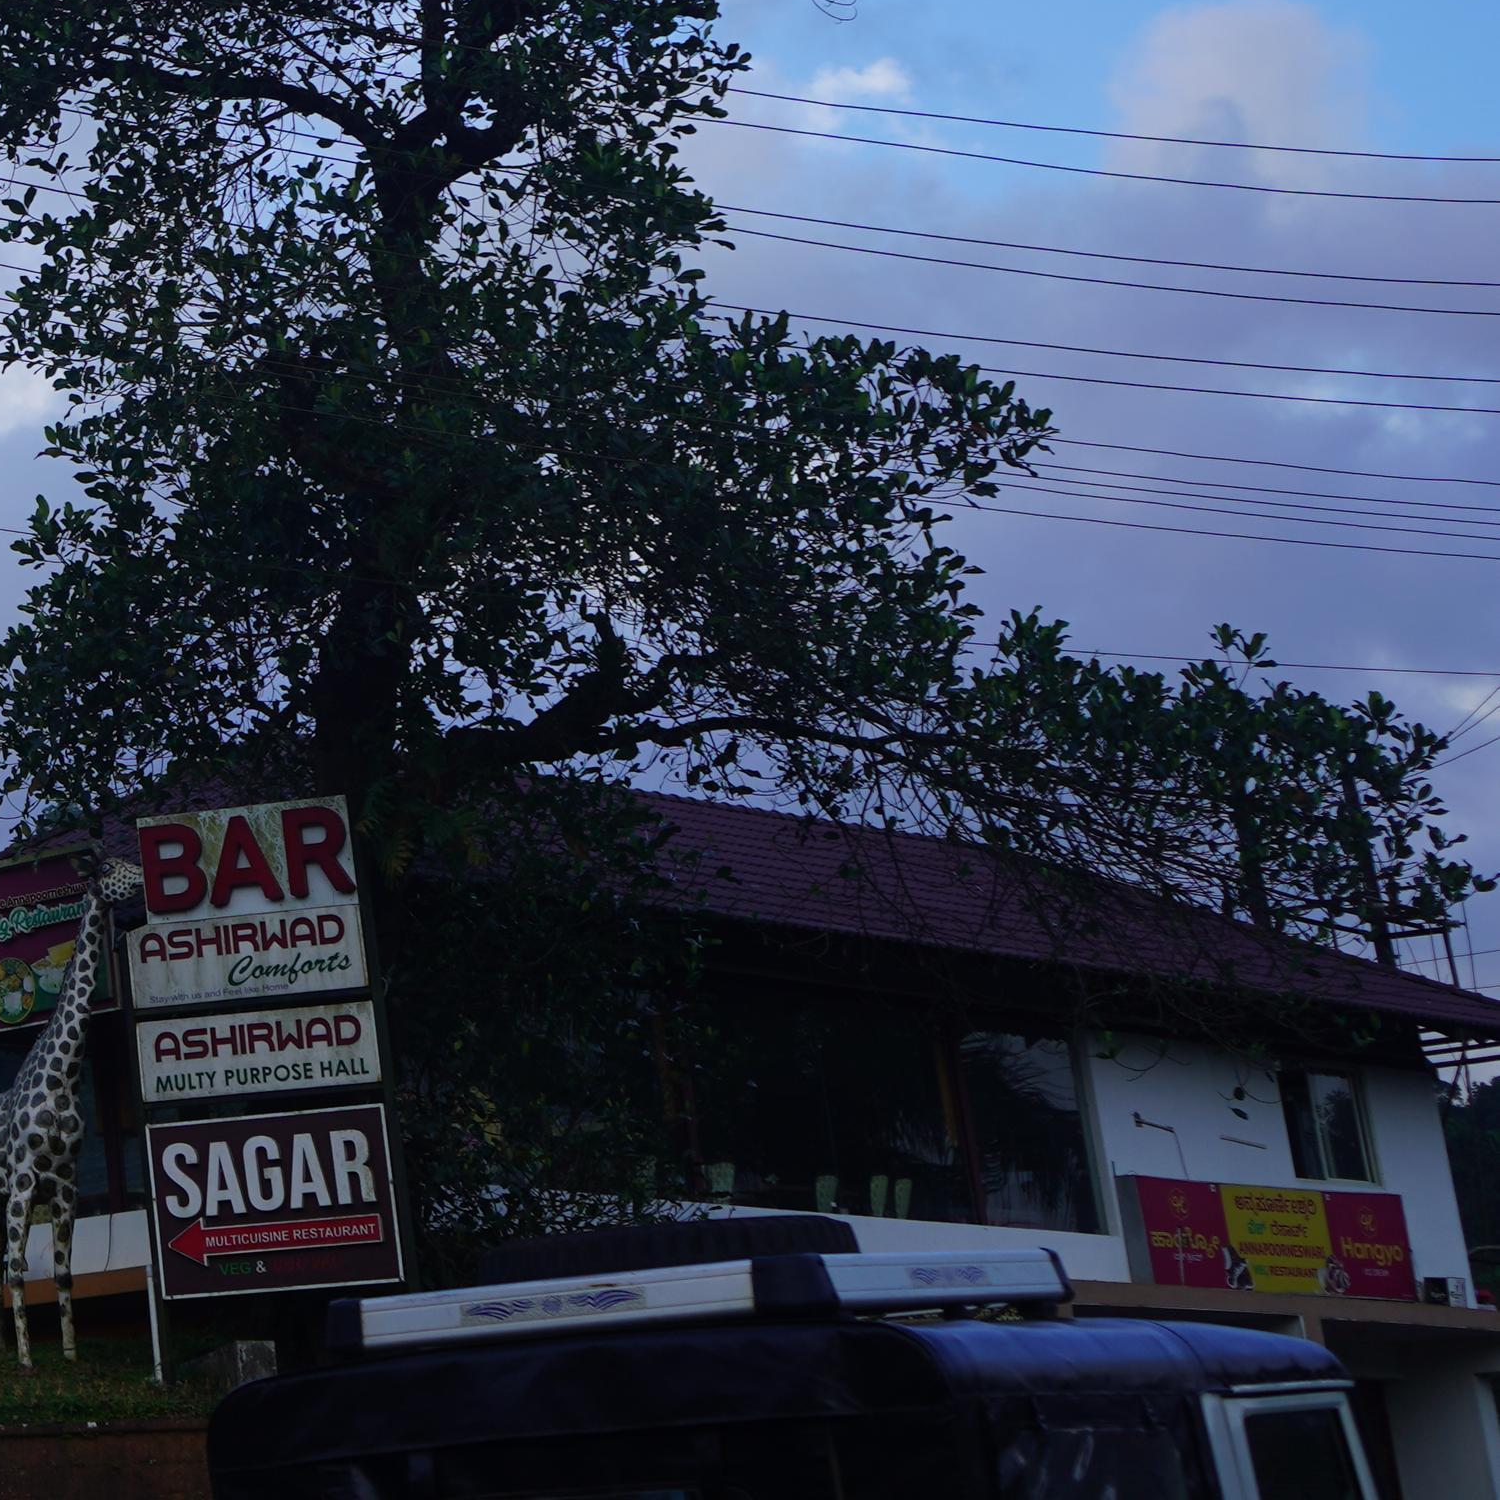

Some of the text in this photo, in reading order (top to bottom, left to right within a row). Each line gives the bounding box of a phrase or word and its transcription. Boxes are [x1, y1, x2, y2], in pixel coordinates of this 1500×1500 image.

[138, 806, 357, 914] BAR
[139, 914, 345, 964] ASHIRWAD
[227, 950, 352, 986] Comforts
[204, 989, 222, 999] and
[262, 982, 289, 993] Home
[154, 1014, 361, 1063] ASHIRWAD
[155, 1057, 370, 1094] MULTY PURPOSE HALL
[161, 1128, 377, 1219] SAGAR
[205, 1223, 376, 1249] MULTICUISINE RESTAURANT
[1340, 1236, 1404, 1267] Hangyo
[218, 1260, 252, 1276] VEG
[256, 1260, 268, 1274] &
